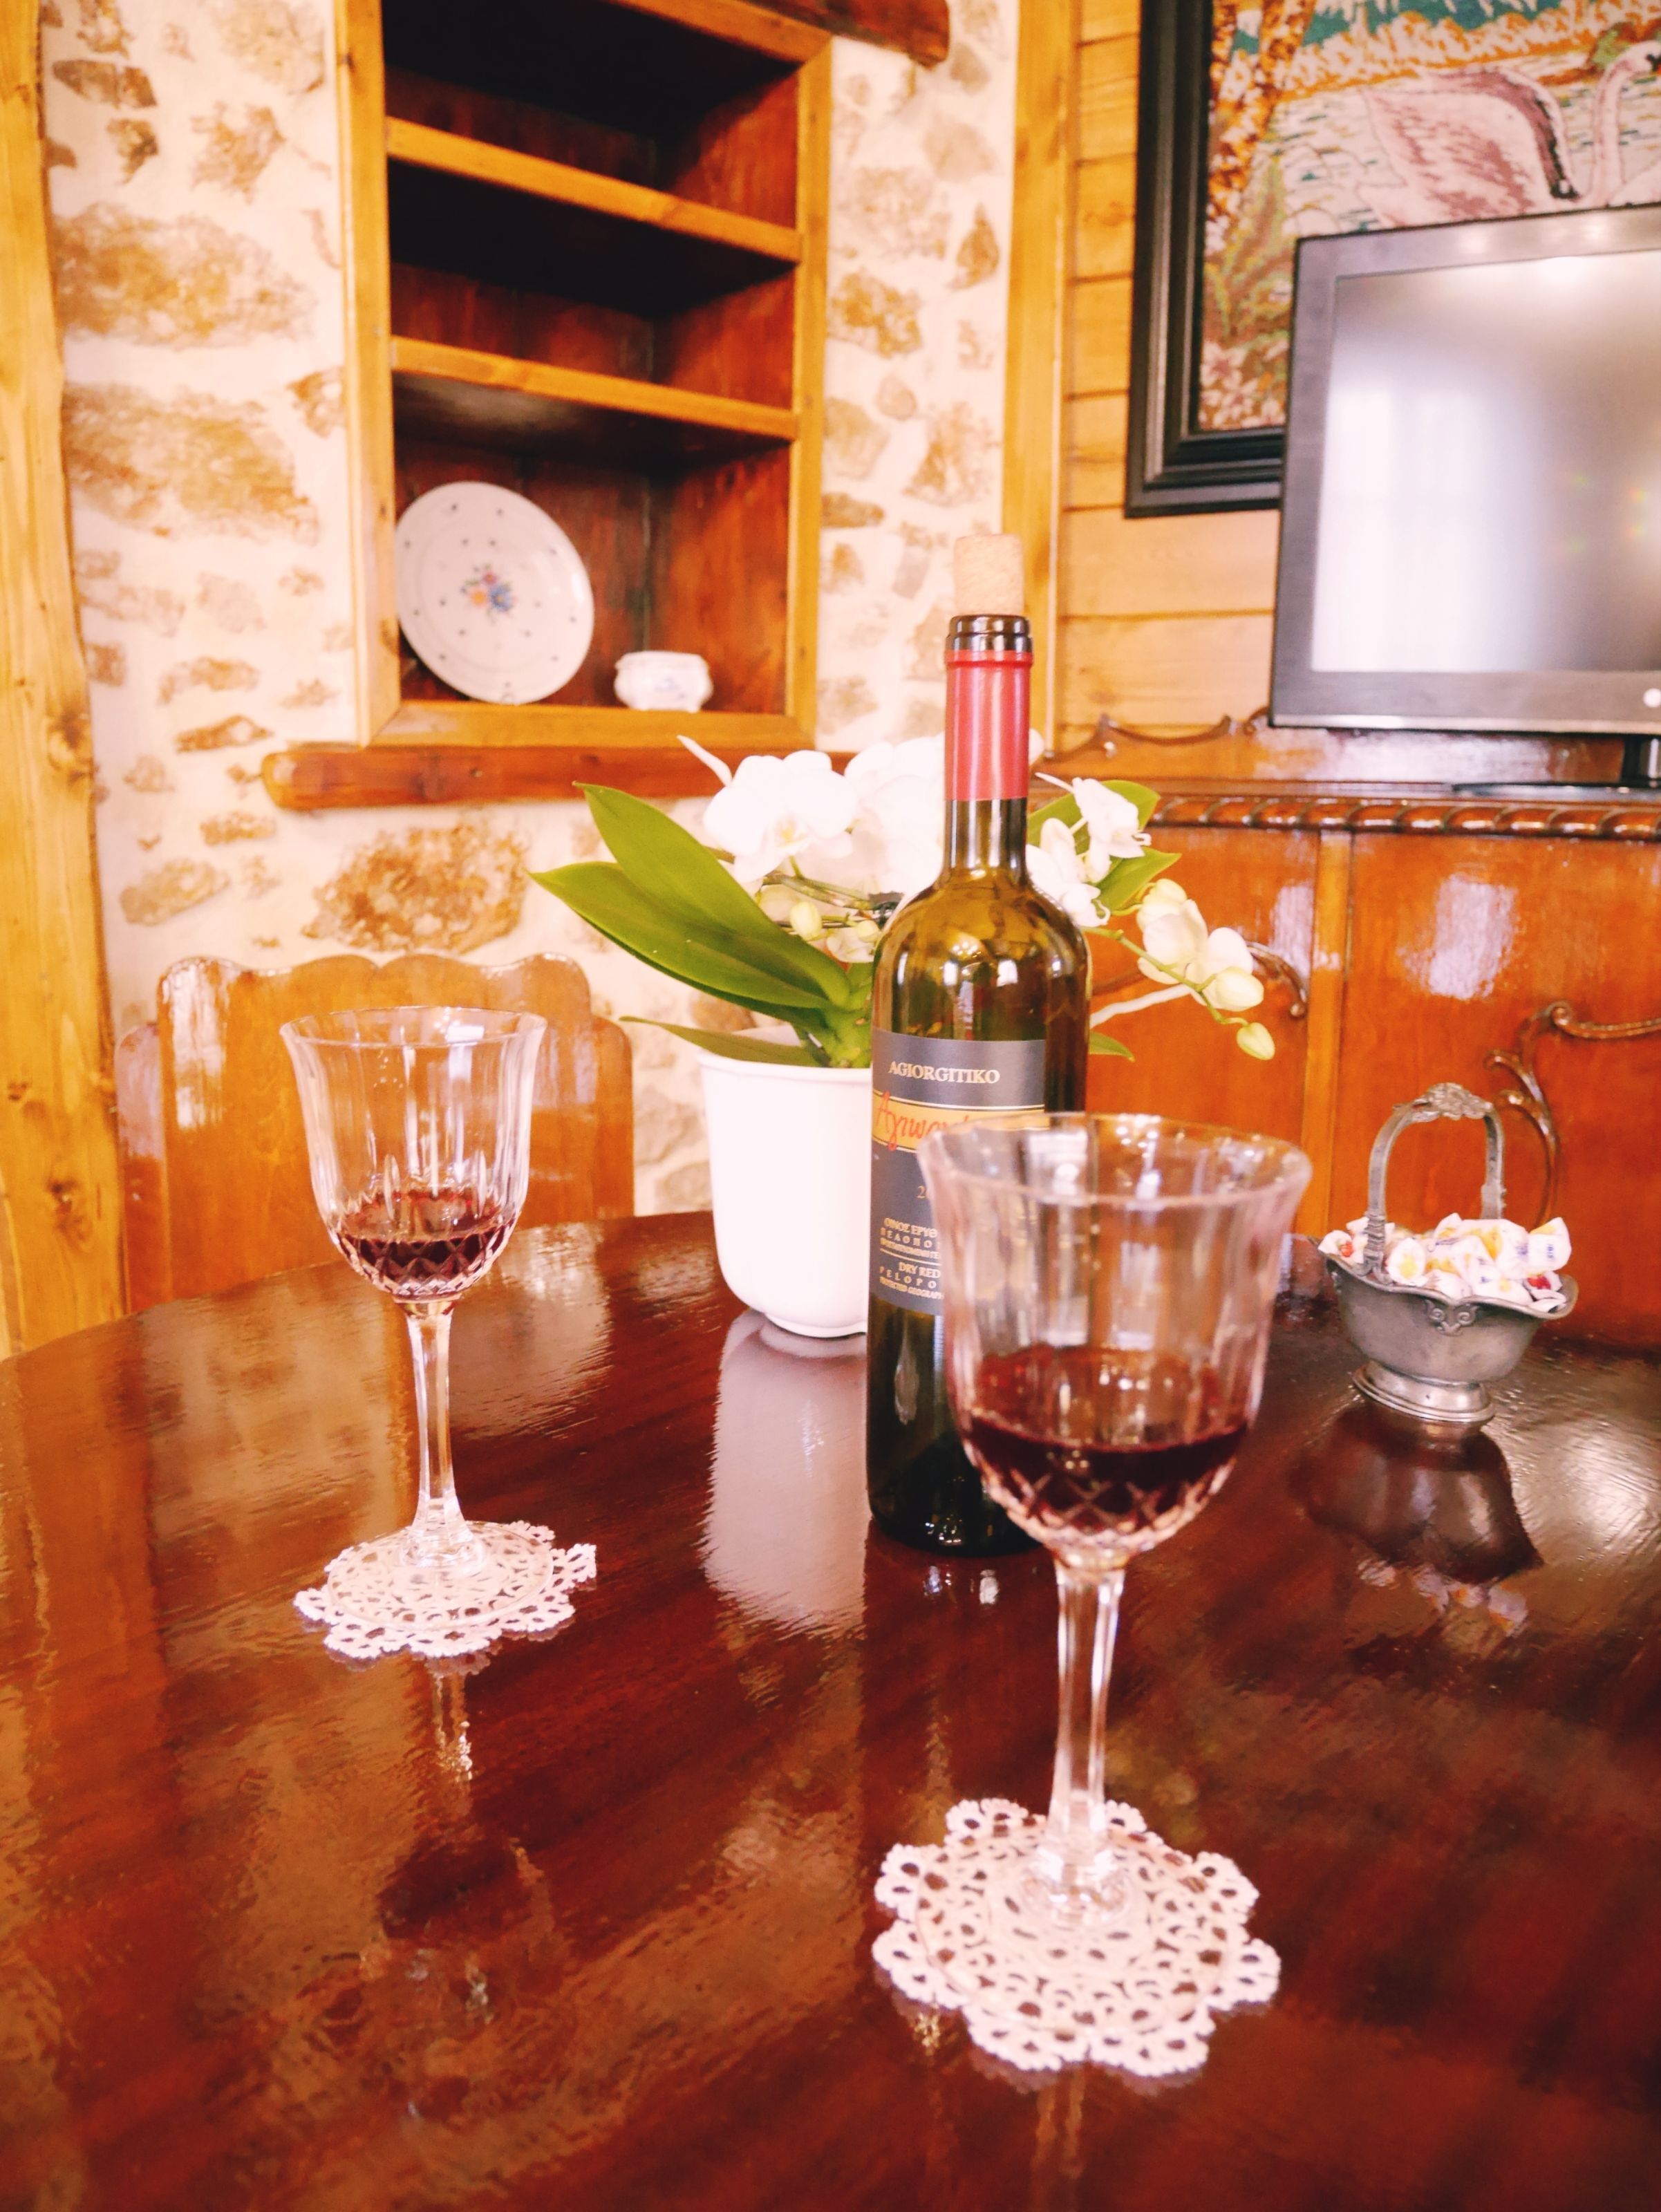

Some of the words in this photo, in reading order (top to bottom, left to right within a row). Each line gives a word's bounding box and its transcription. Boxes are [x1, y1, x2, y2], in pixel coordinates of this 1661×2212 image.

[888, 1061, 1000, 1084] AGIORGITIKO
[899, 1262, 918, 1275] DRY
[919, 1266, 941, 1278] RED
